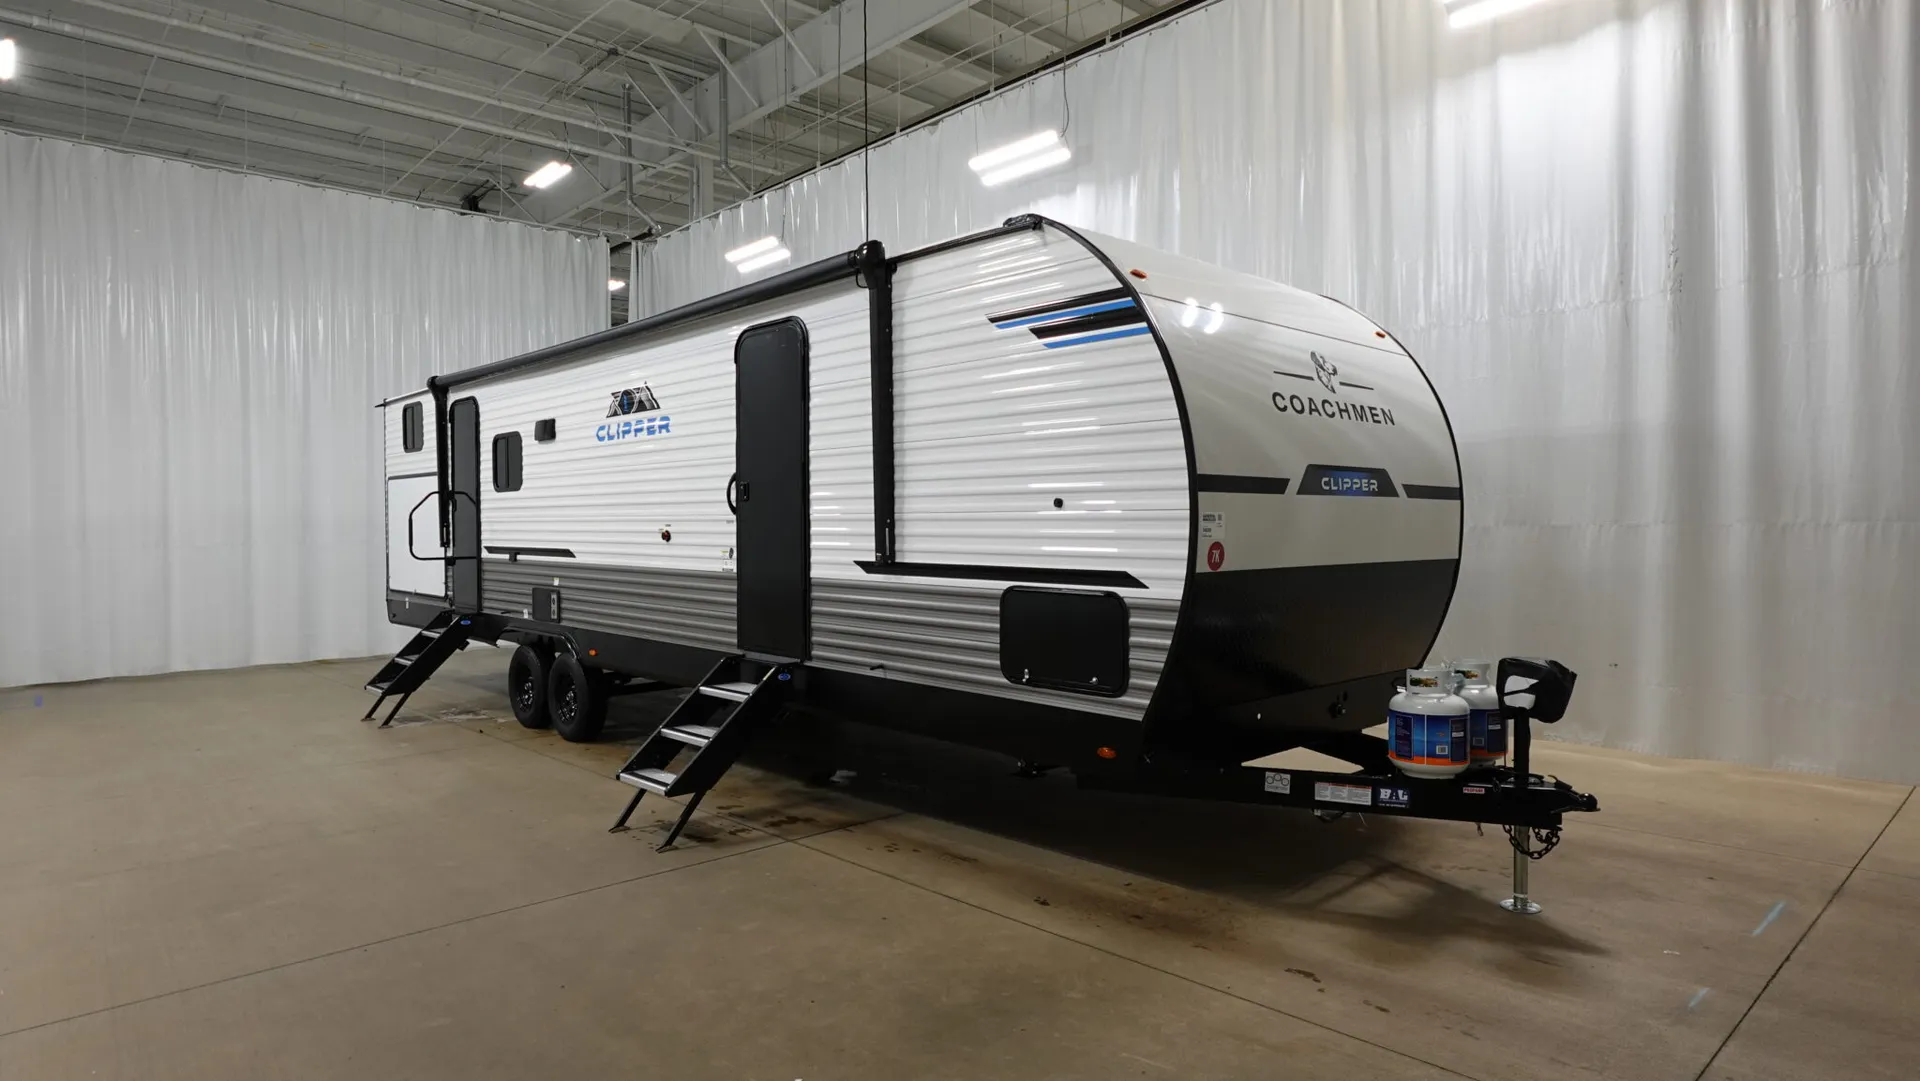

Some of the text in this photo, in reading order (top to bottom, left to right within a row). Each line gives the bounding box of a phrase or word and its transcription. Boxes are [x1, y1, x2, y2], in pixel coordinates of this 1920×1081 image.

[1271, 391, 1396, 426] COACHMEN
[596, 416, 671, 442] CLIPPER
[1321, 476, 1379, 492] CLIPPER
[1211, 549, 1221, 563] 7K
